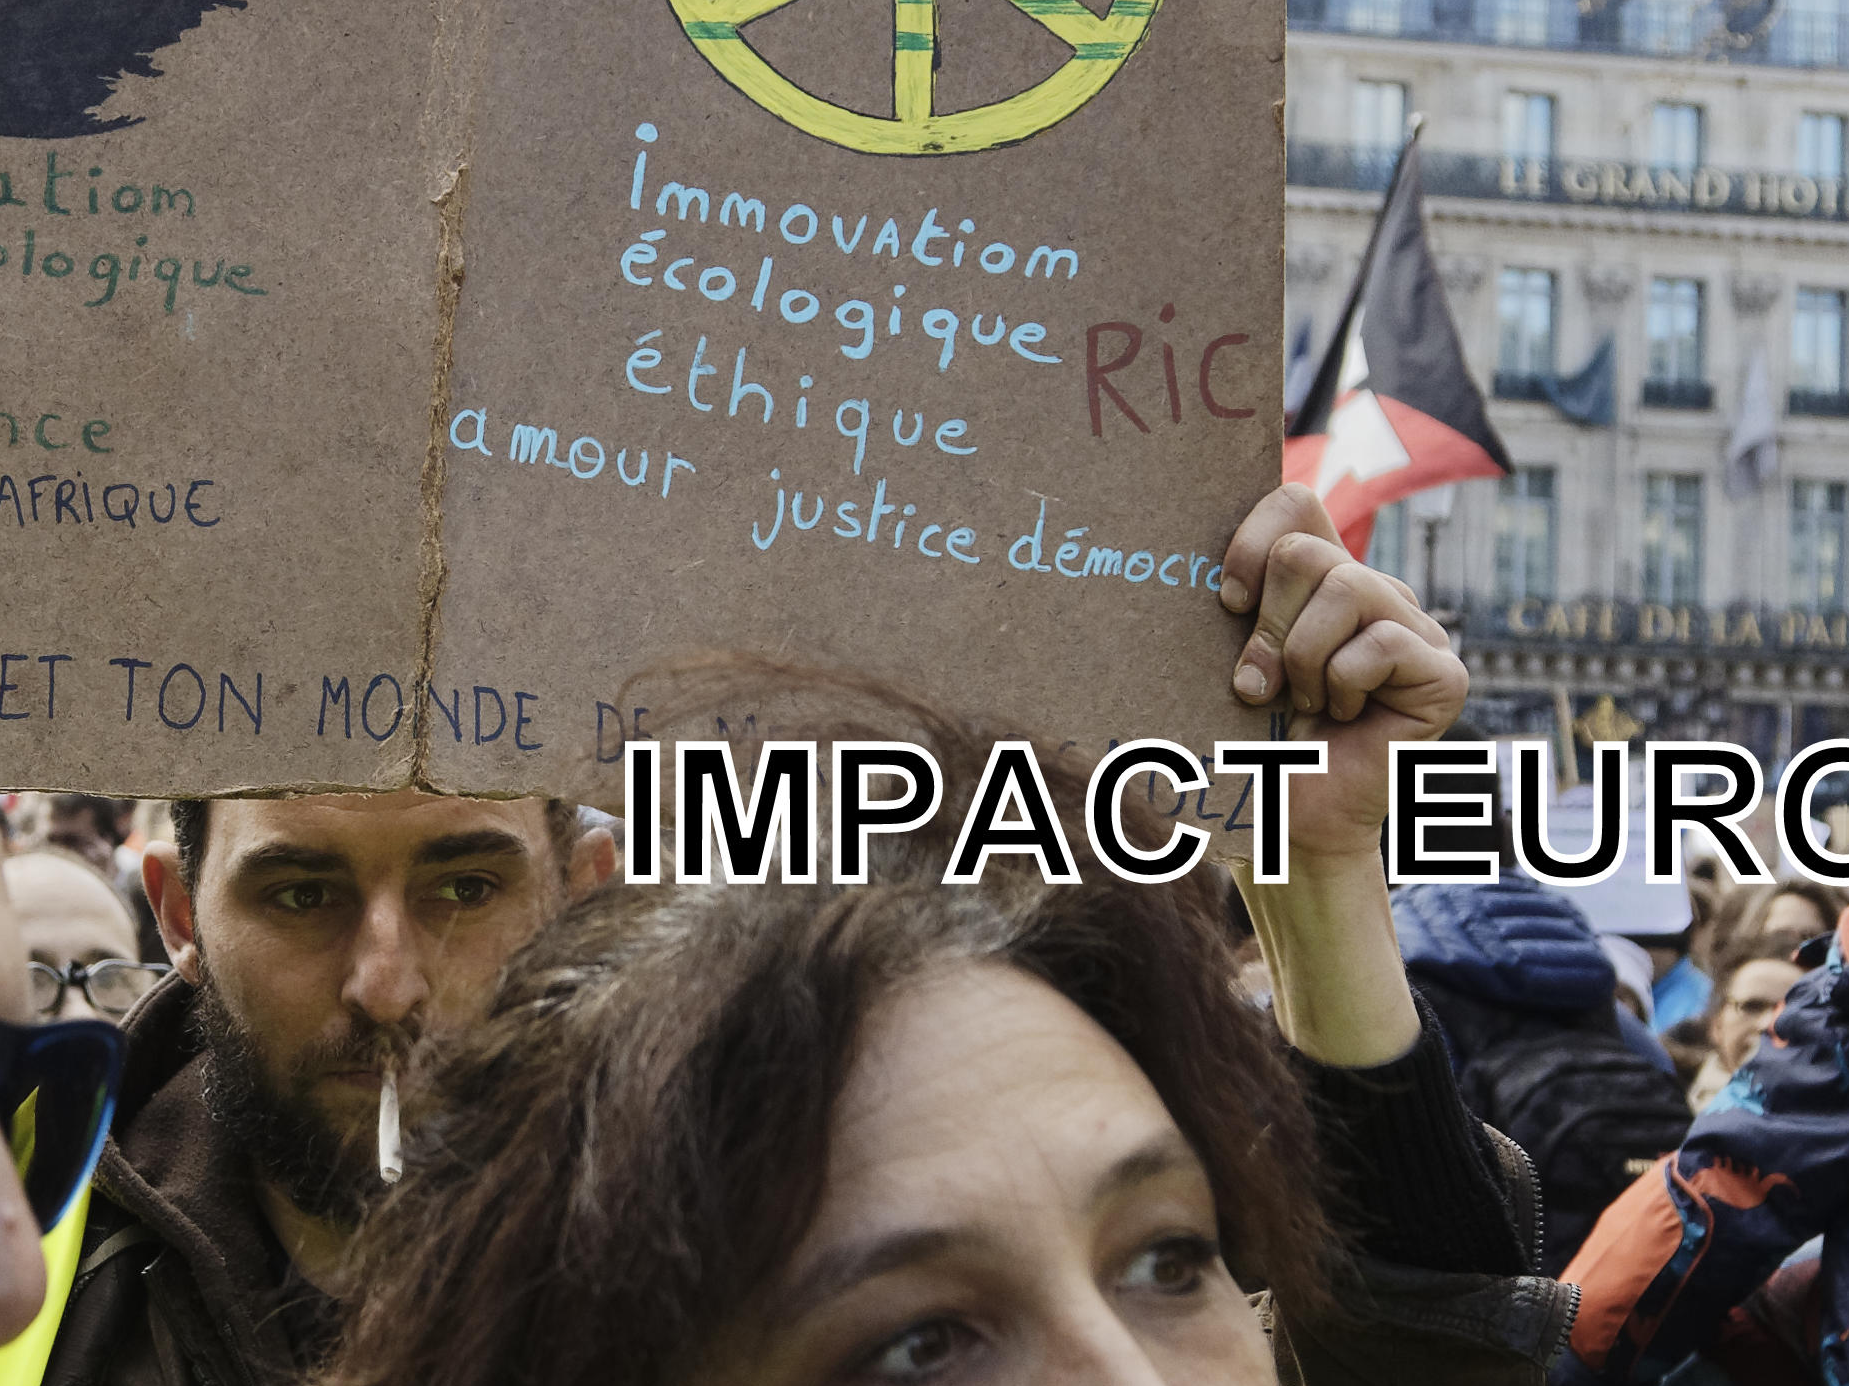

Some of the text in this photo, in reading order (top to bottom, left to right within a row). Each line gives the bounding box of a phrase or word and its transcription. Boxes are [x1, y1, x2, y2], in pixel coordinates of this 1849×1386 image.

[1499, 154, 1547, 196] LE
[1561, 160, 1732, 208] GRAND
[620, 229, 1063, 370] écologique
[626, 329, 978, 475] éthique
[449, 408, 697, 499] amour
[752, 468, 981, 565] justice
[110, 658, 263, 735] TON
[317, 673, 544, 751] MONDE
